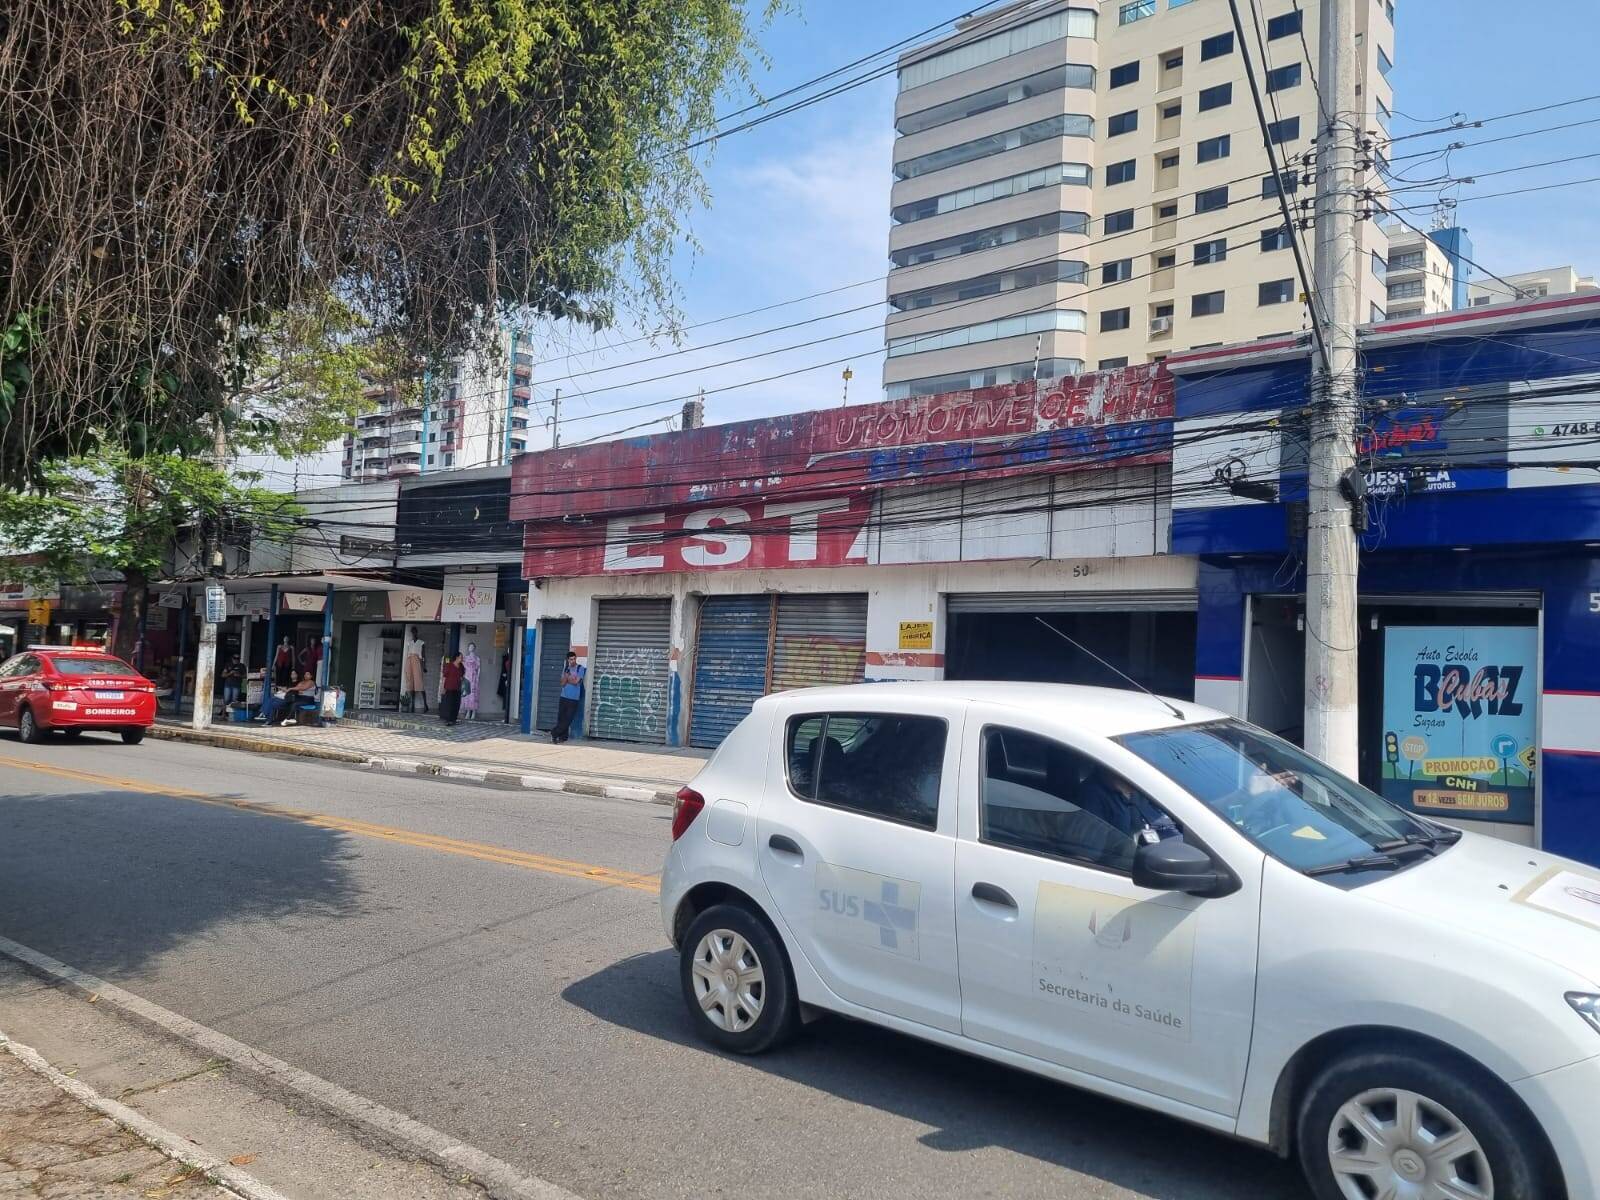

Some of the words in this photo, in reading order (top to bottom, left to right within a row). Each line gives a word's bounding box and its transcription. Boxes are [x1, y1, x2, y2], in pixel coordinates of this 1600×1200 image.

[1416, 646, 1441, 661] Auto
[1445, 645, 1479, 662] Escola
[1414, 663, 1524, 720] BRAZ
[1437, 669, 1509, 710] Cubas
[85, 708, 136, 716] BOMBEIROS
[1413, 714, 1446, 729] Suzano
[1404, 742, 1424, 754] STOP
[1425, 758, 1495, 773] PROMOÇÃO
[1445, 776, 1477, 791] CNH
[1475, 794, 1505, 809] JUROS
[819, 888, 860, 918] SUS
[1039, 977, 1109, 1008] Secretaria
[1112, 999, 1131, 1015] da
[1134, 1004, 1183, 1029] Saúde
